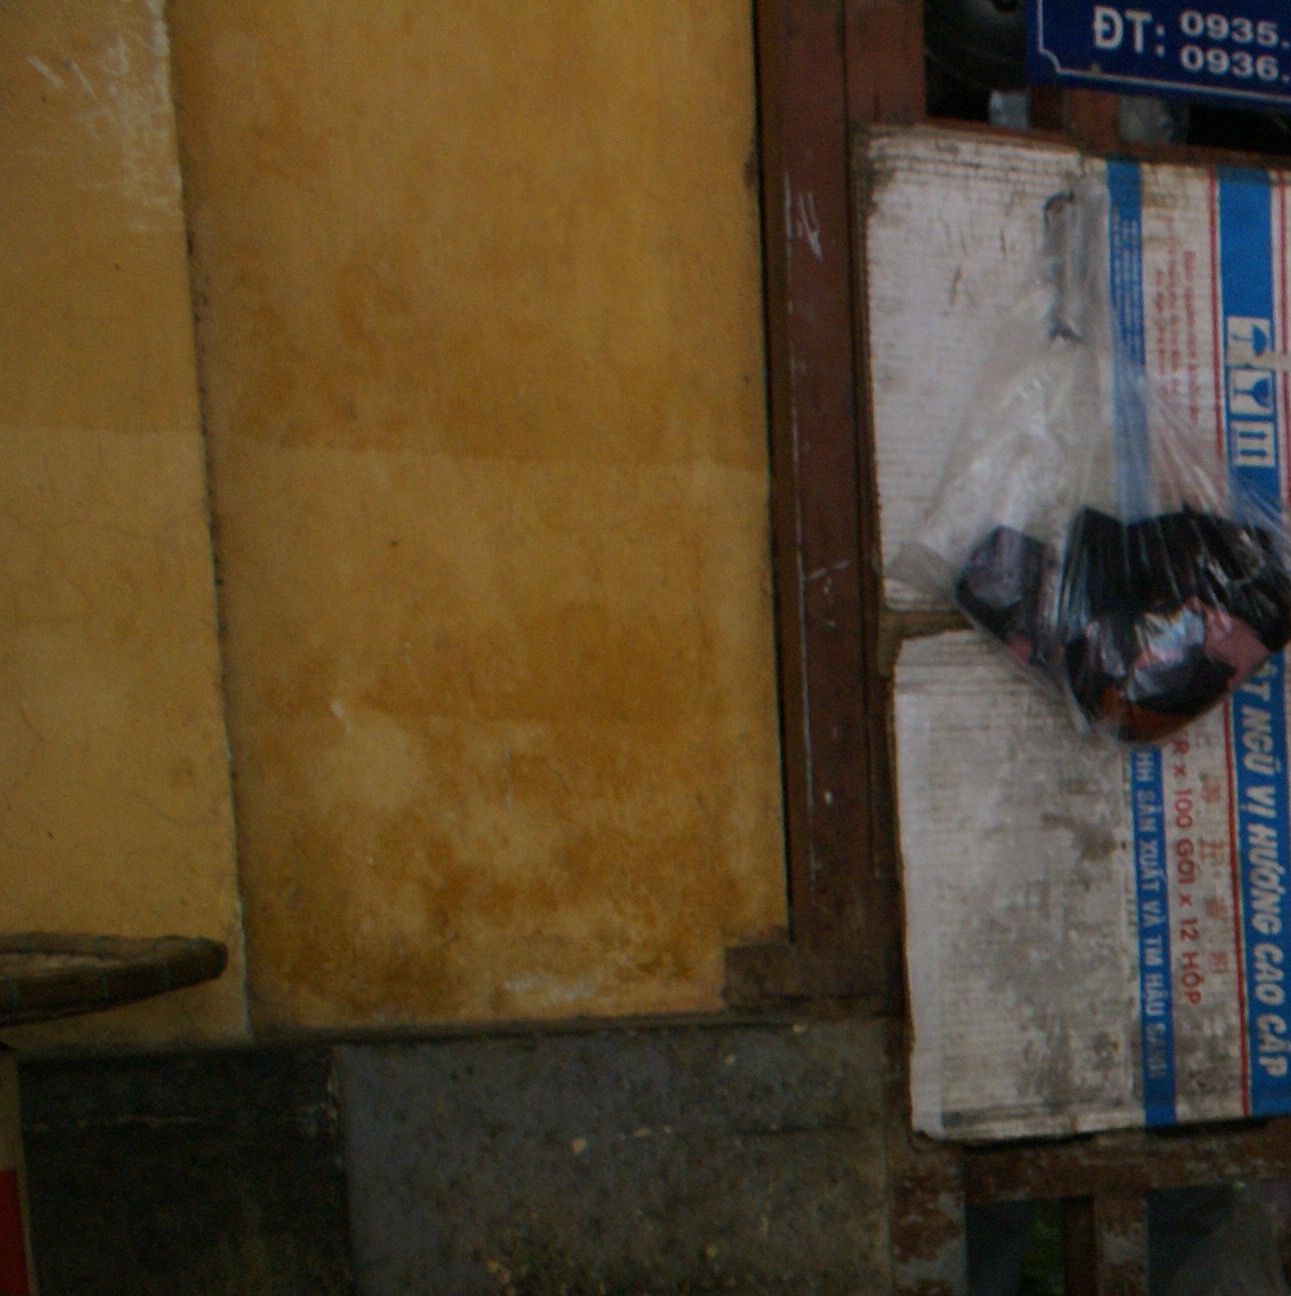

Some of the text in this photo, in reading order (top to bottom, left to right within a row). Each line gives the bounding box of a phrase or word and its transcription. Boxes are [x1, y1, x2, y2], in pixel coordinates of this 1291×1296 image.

[1092, 5, 1166, 56] ĐT:
[1241, 706, 1281, 776] NGŨ
[1174, 788, 1194, 829] 100
[1241, 786, 1277, 818] VỊ
[1247, 823, 1287, 935] HƯƠNG
[1180, 917, 1199, 942] 12
[1253, 943, 1285, 1006] CAO
